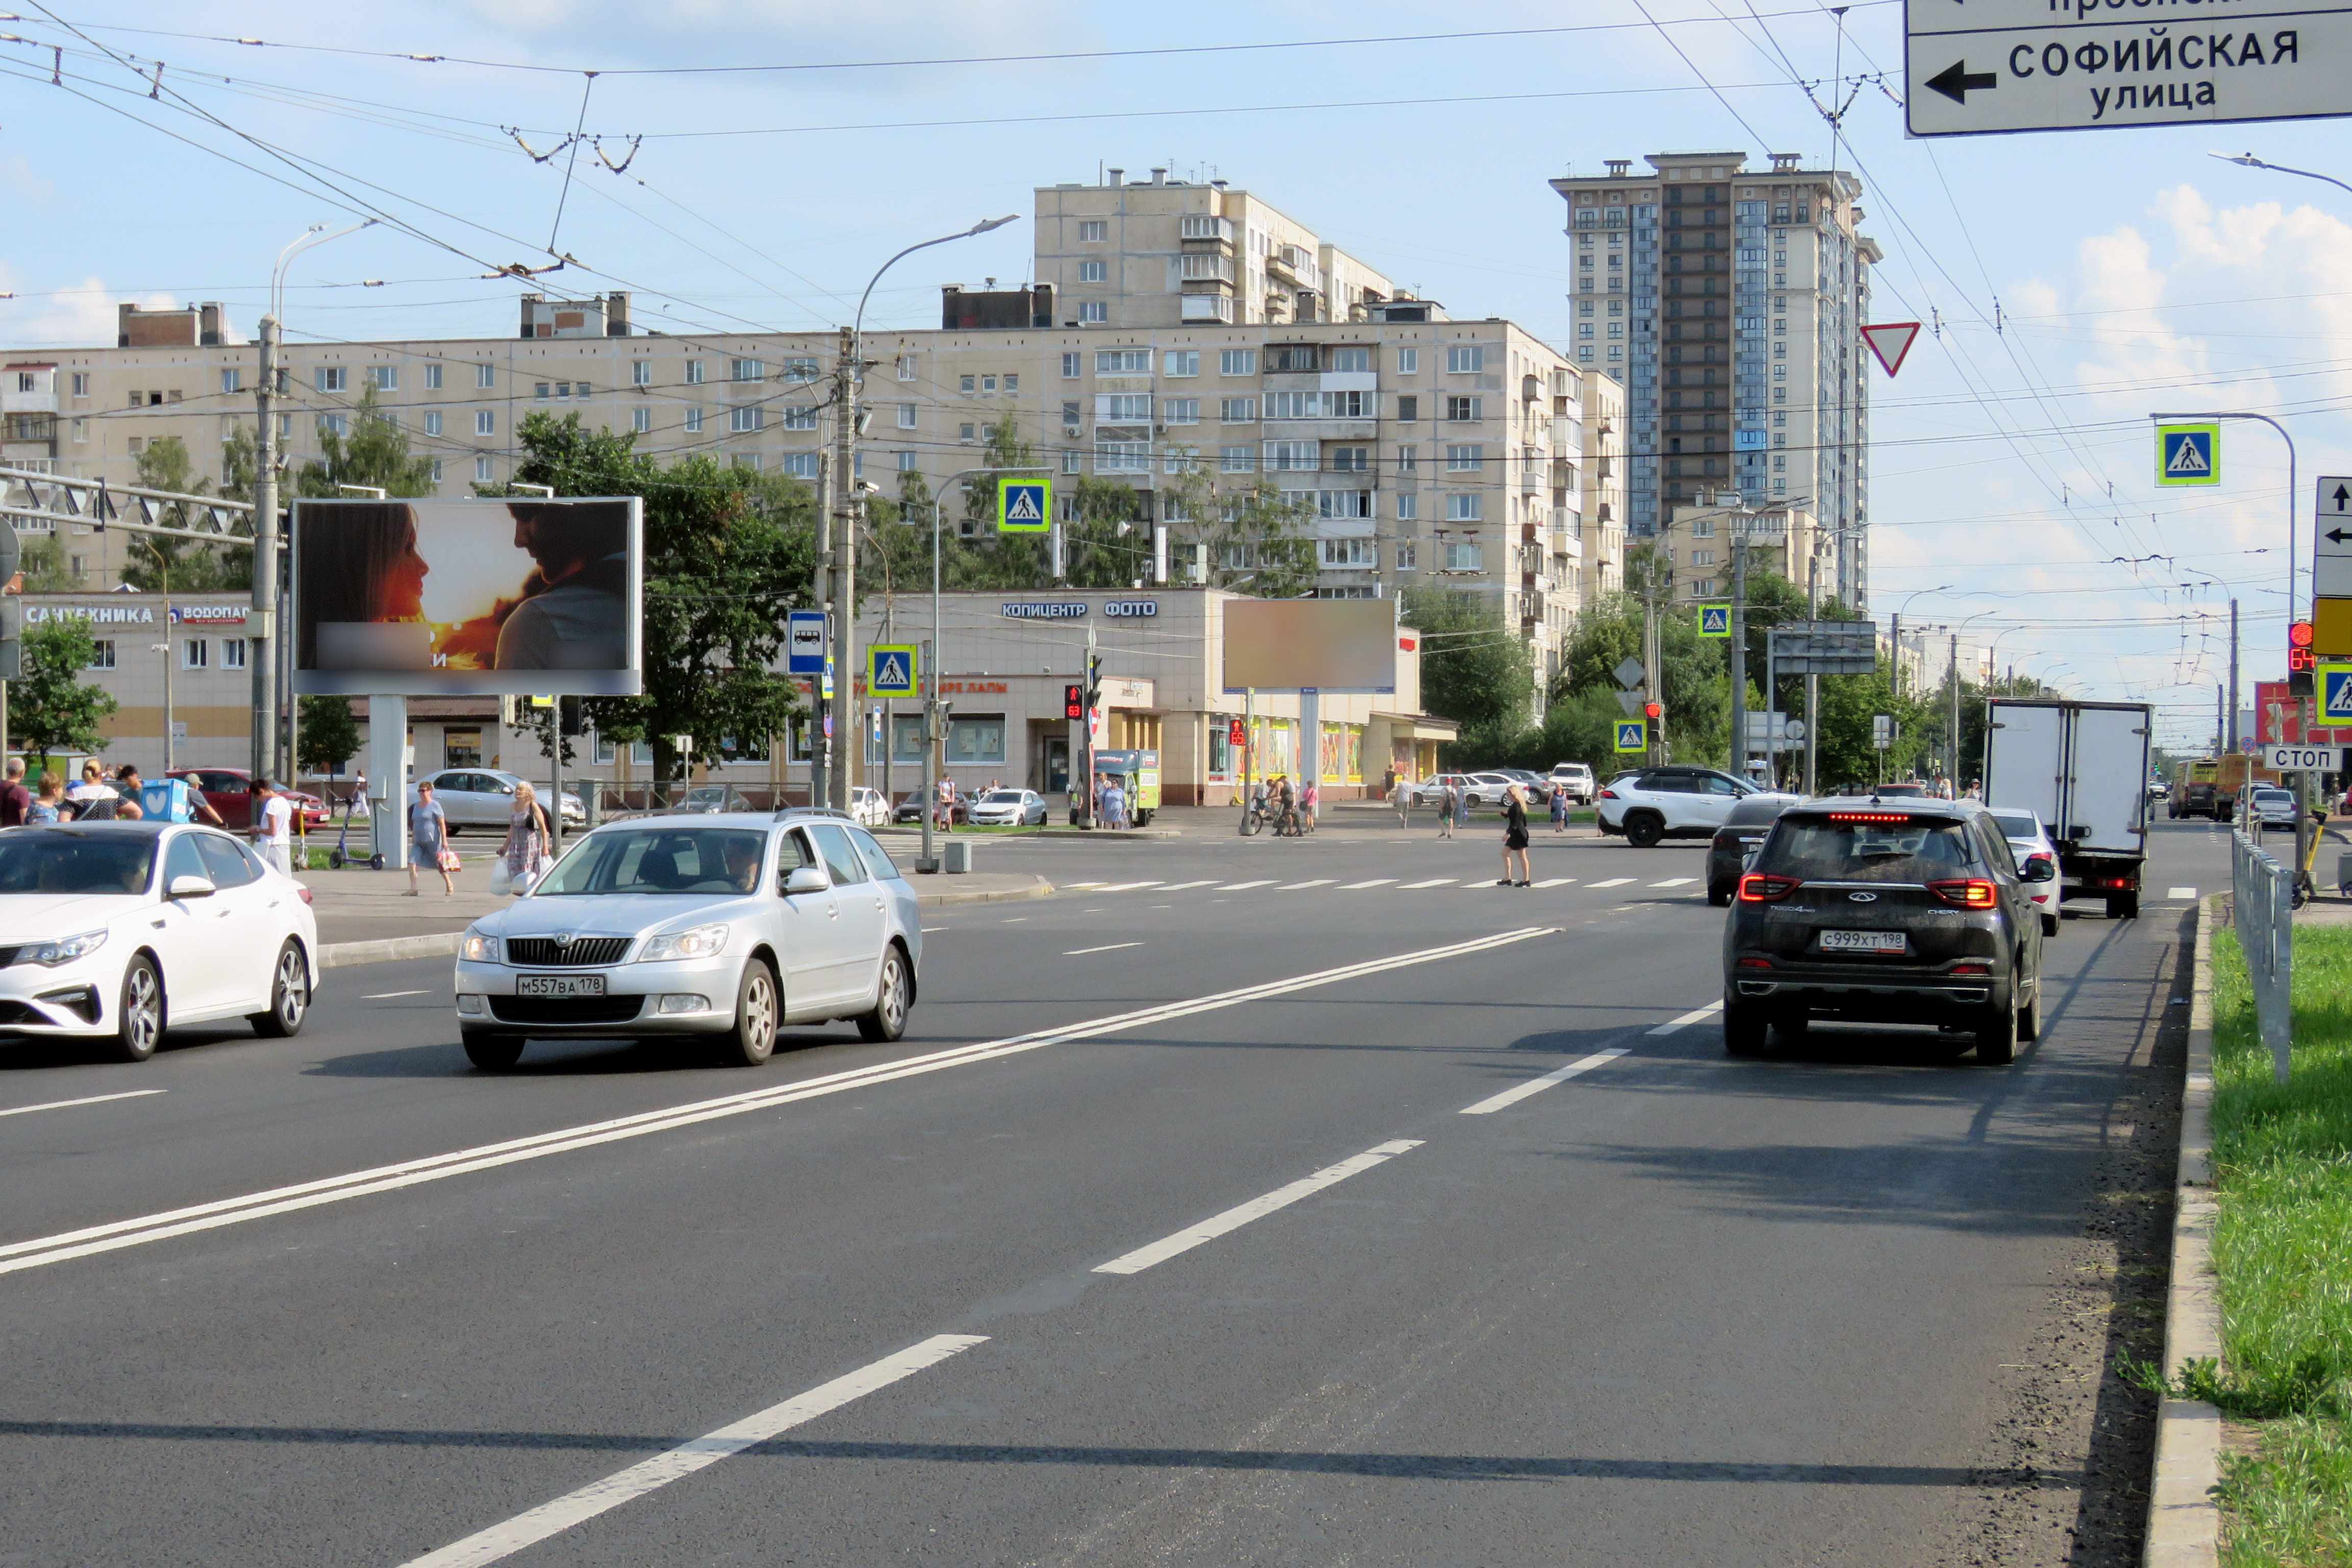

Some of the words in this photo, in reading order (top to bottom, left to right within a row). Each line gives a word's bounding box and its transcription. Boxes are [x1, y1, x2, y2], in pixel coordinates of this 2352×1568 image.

[2009, 27, 2298, 78] СОФИЙСКАЯ
[2090, 80, 2217, 120] улица
[1002, 603, 1087, 618] КОПИЦЕНТР
[1105, 601, 1157, 617] ФОТО
[2290, 649, 2315, 670] 64
[967, 682, 1008, 694] ЛАПЫ
[1068, 705, 1080, 716] 63
[1231, 732, 1244, 744] 65
[2276, 750, 2330, 767] СТОП
[1882, 934, 1902, 943] 198
[579, 978, 600, 989] 178
